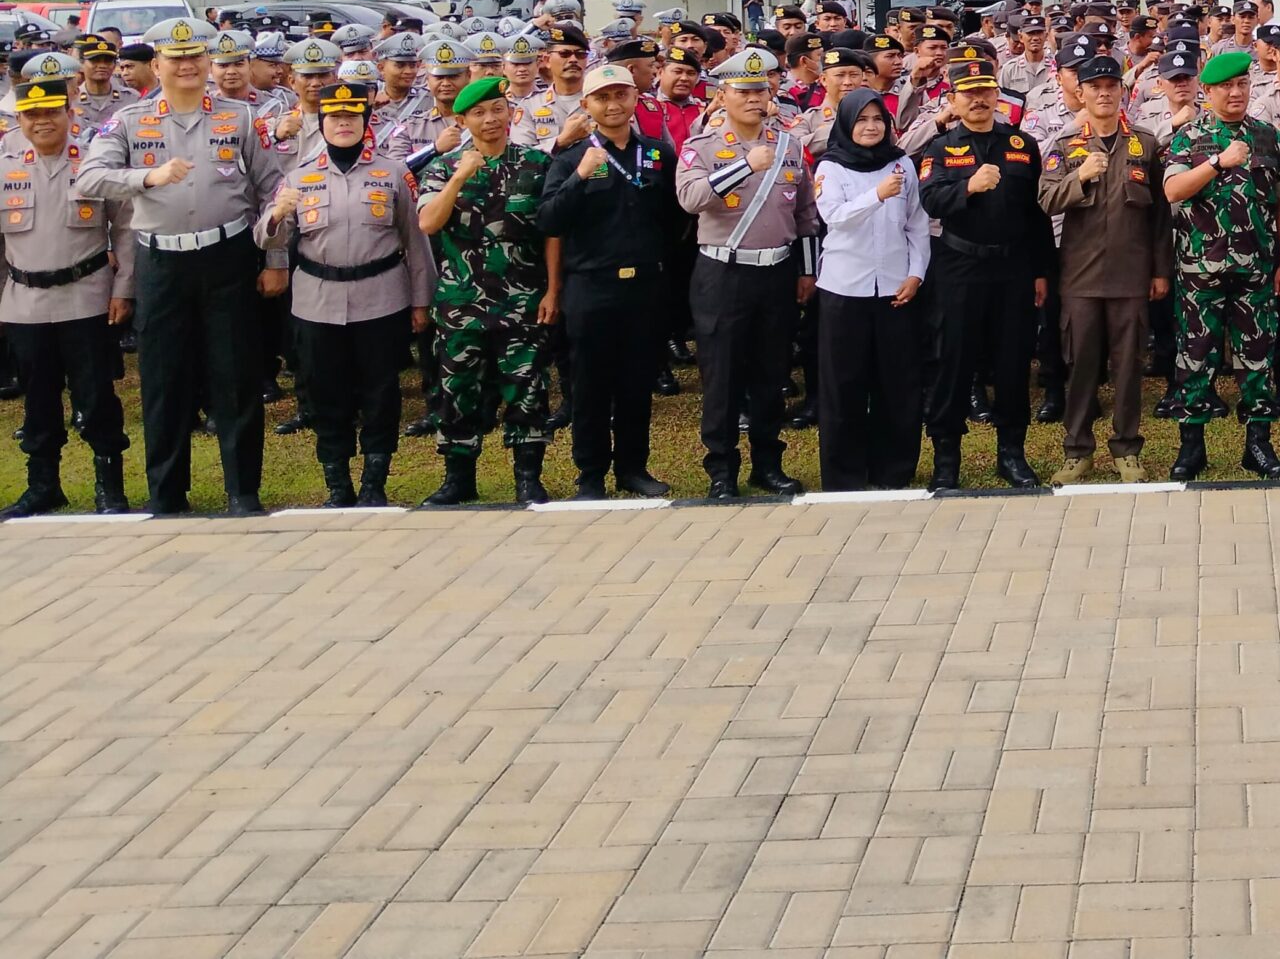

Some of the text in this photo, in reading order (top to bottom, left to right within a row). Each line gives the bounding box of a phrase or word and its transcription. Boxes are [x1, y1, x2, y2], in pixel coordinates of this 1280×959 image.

[209, 137, 240, 146] POLRI
[3, 182, 31, 191] MUJI
[364, 181, 393, 189] POLRI
